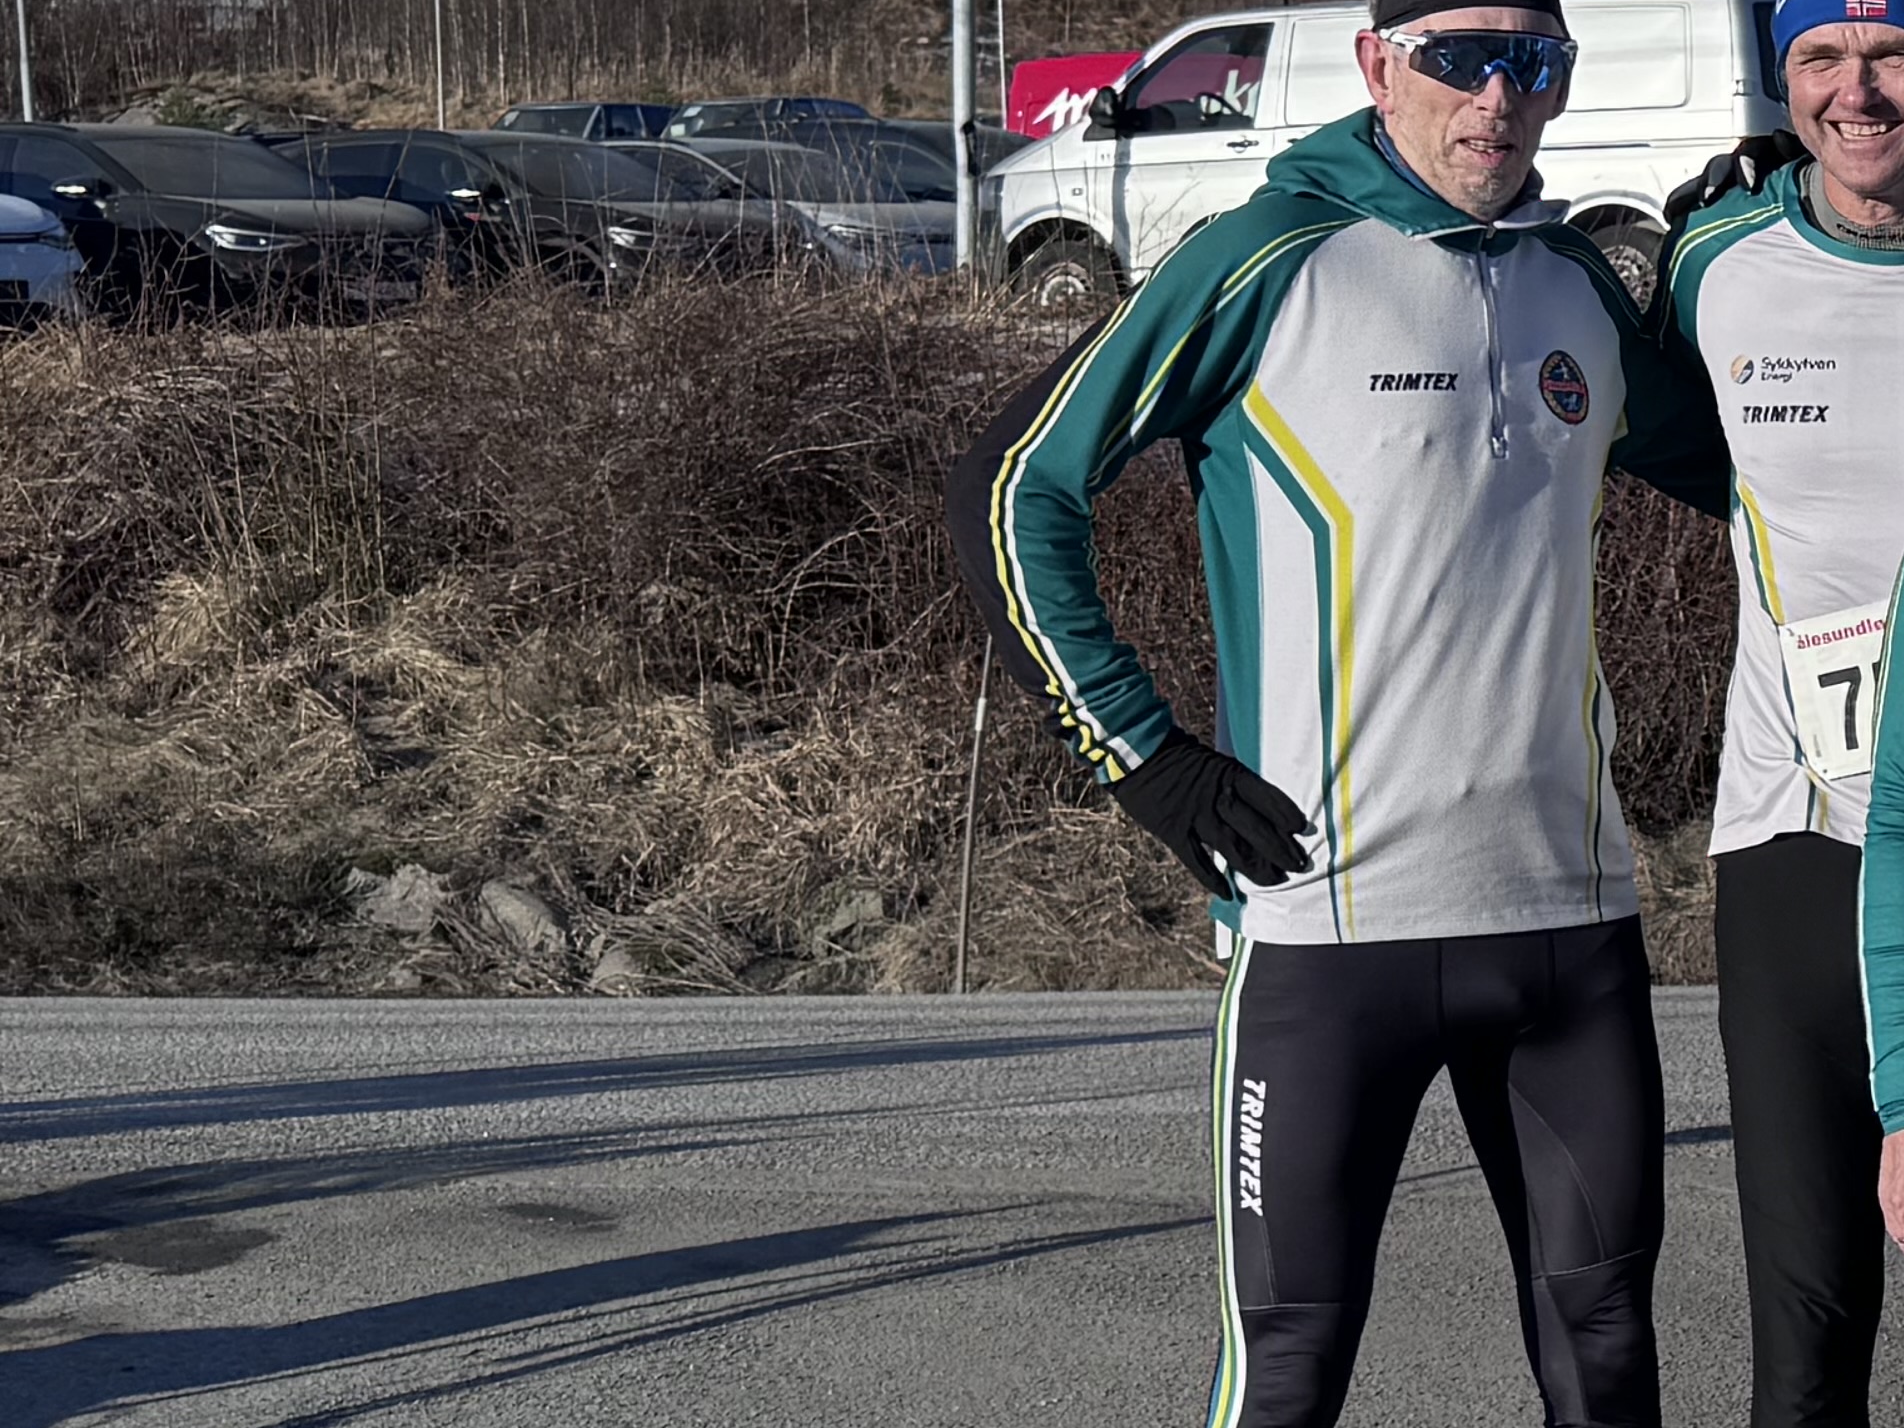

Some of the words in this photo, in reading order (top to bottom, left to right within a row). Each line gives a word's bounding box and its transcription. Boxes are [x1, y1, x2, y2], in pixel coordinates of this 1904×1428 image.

[1370, 373, 1459, 392] TRIMTEX
[1743, 405, 1830, 424] TRIMTEX
[1796, 618, 1887, 650] ålesundlø
[1817, 660, 1882, 751] 7
[1239, 1078, 1267, 1217] TRIMTEX
